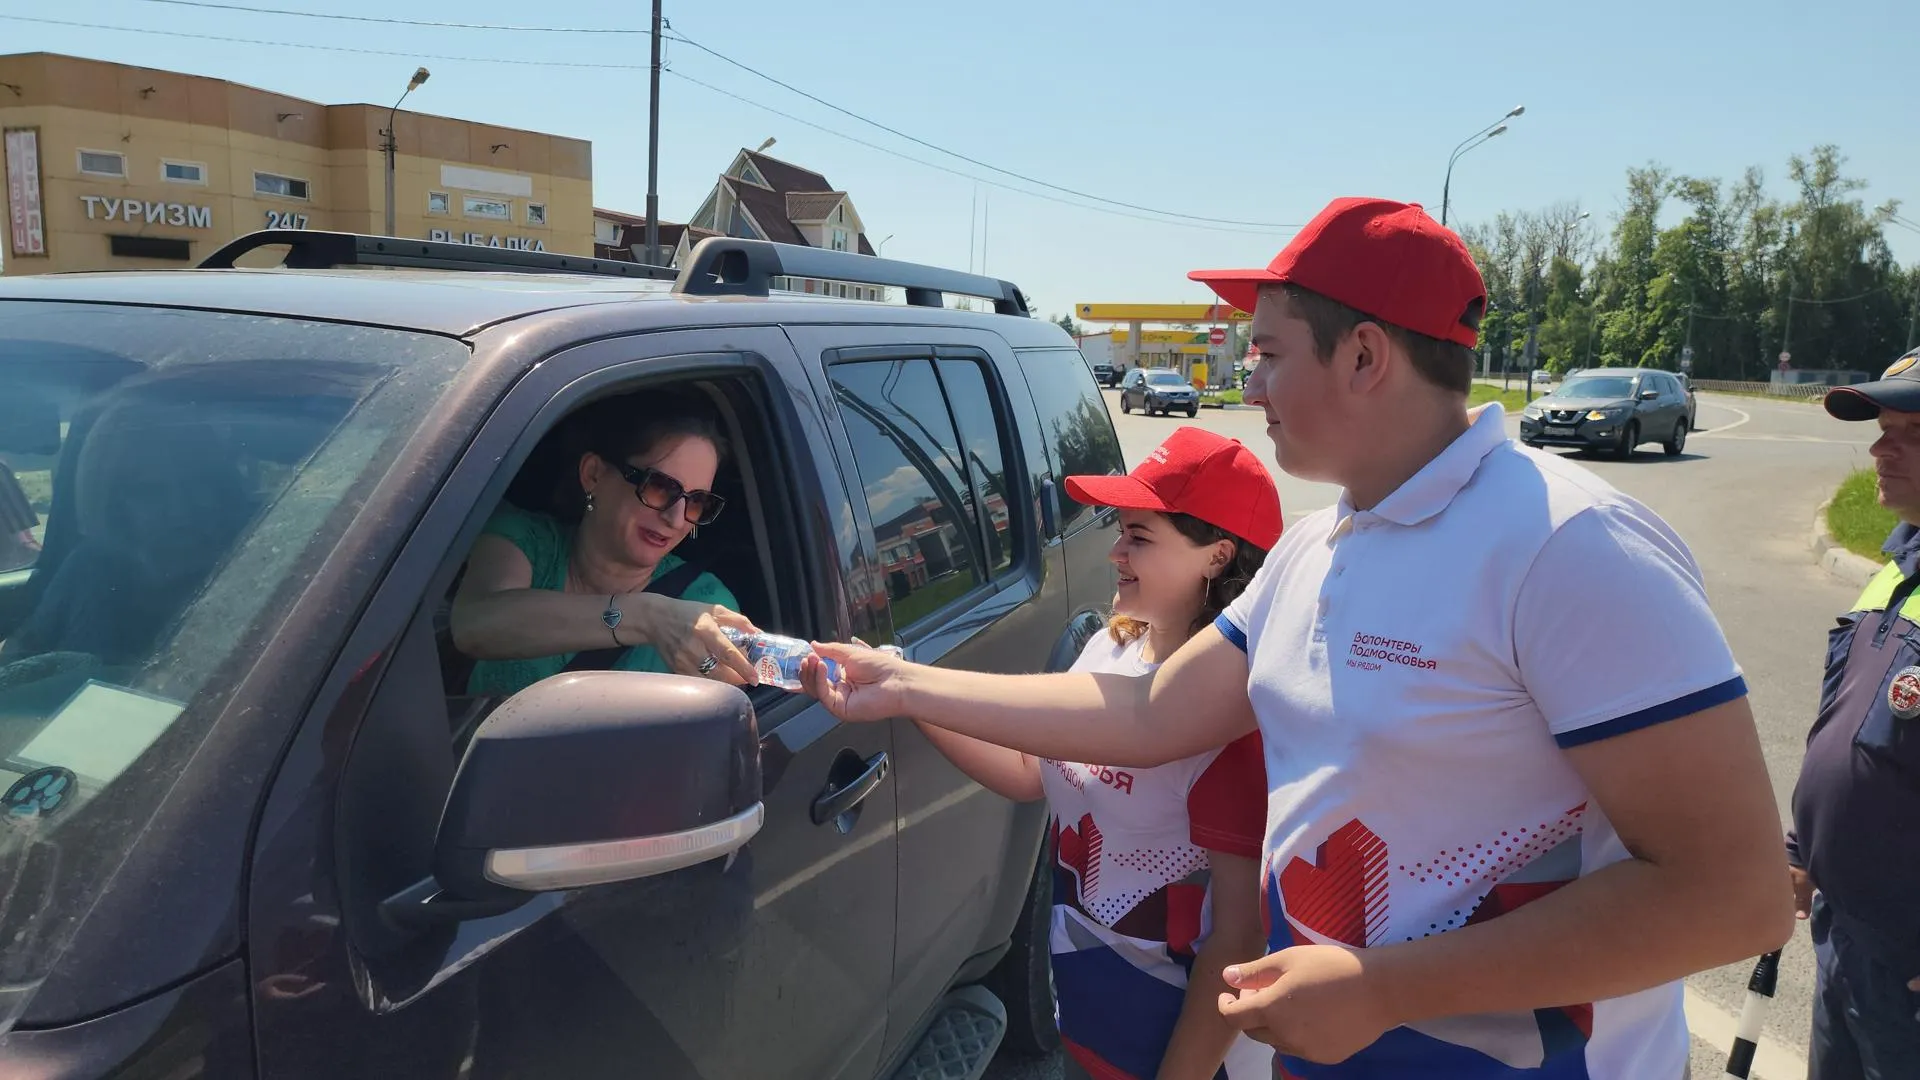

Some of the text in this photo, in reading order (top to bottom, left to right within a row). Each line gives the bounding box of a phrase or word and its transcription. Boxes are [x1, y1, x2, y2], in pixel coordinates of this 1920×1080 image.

[80, 196, 212, 228] ТУРИЗМ
[266, 210, 309, 230] 24/7
[1349, 644, 1437, 670] ПОДМОСКОВЬЯ
